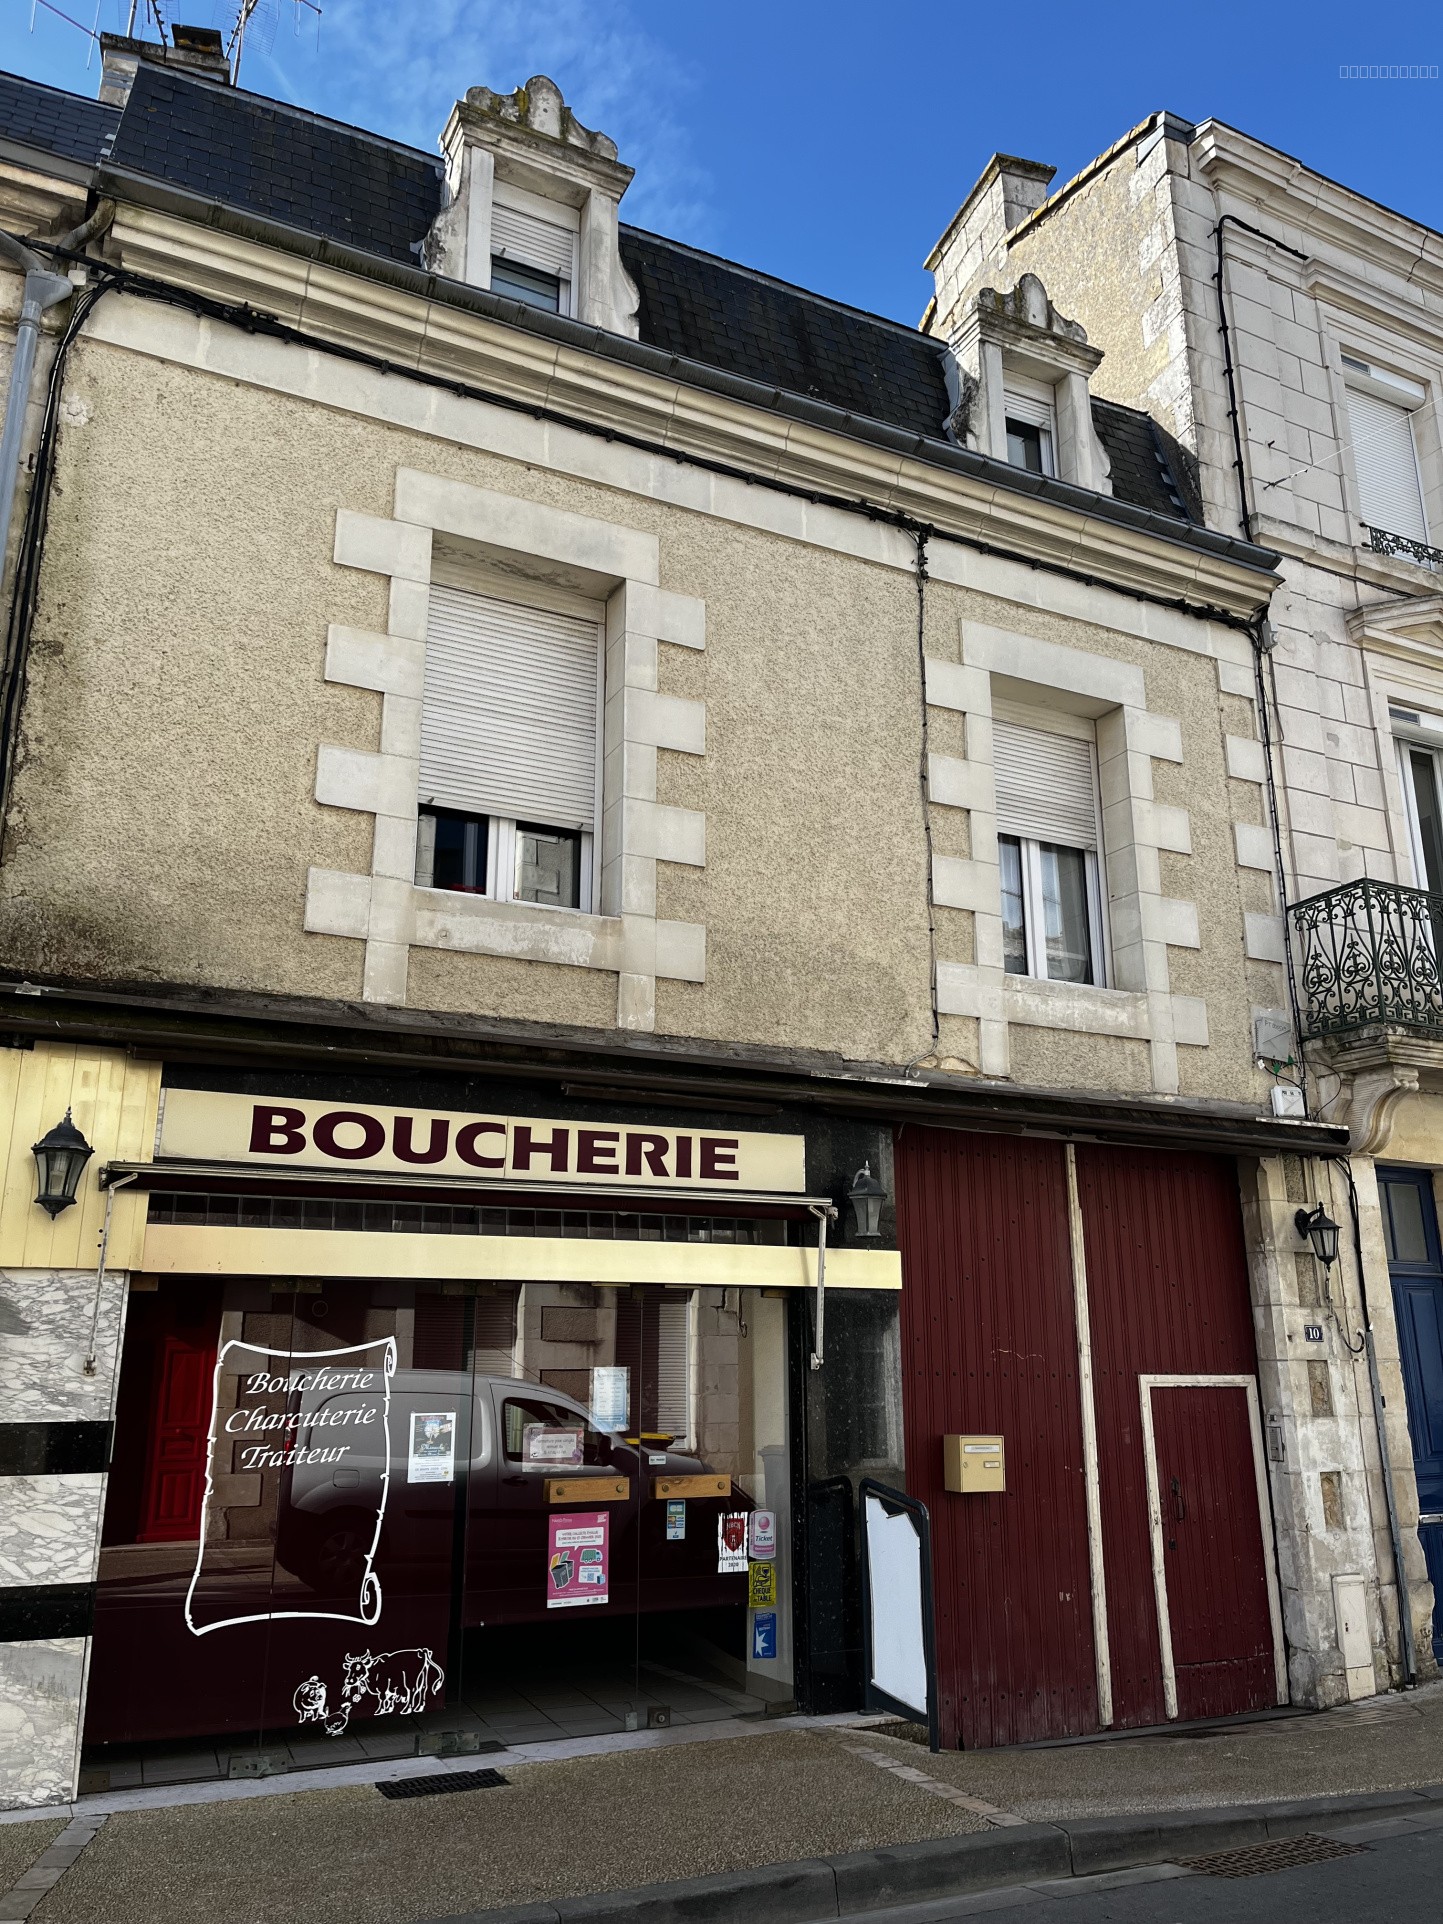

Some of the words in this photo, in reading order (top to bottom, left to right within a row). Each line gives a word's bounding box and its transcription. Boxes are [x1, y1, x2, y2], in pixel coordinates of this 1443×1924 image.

[249, 1104, 740, 1181] BOUCHERIE
[1308, 1327, 1320, 1340] 10
[245, 1366, 374, 1394] Boucherie
[225, 1403, 377, 1433] Charcuterie
[241, 1443, 351, 1469] Traiteur
